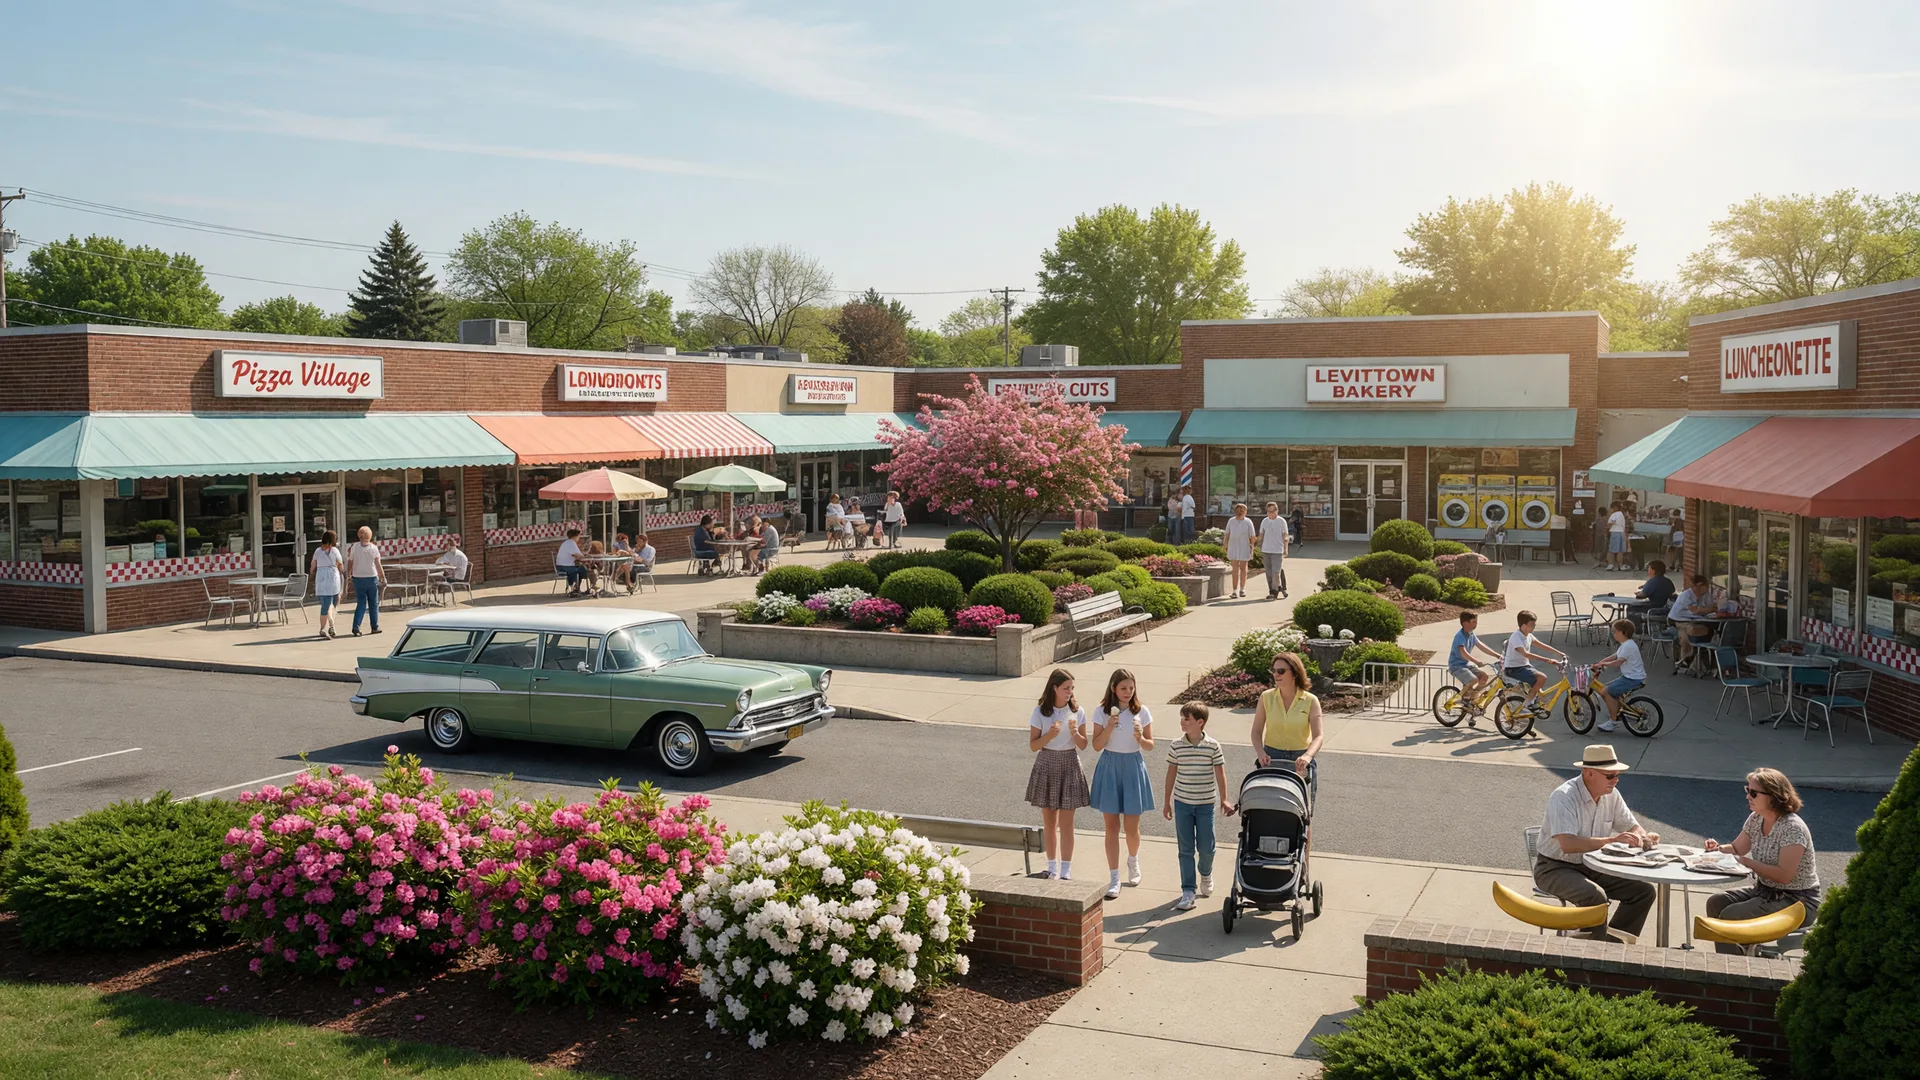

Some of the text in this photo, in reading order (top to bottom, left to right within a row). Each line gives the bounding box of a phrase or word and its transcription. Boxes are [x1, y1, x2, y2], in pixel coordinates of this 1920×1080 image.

[1725, 337, 1832, 379] LUNCHEONETTE
[232, 359, 371, 394] Pizza Village
[1315, 368, 1435, 383] LEVITTOWN
[1070, 382, 1109, 397] CUTS
[1333, 385, 1416, 398] BAKERY
